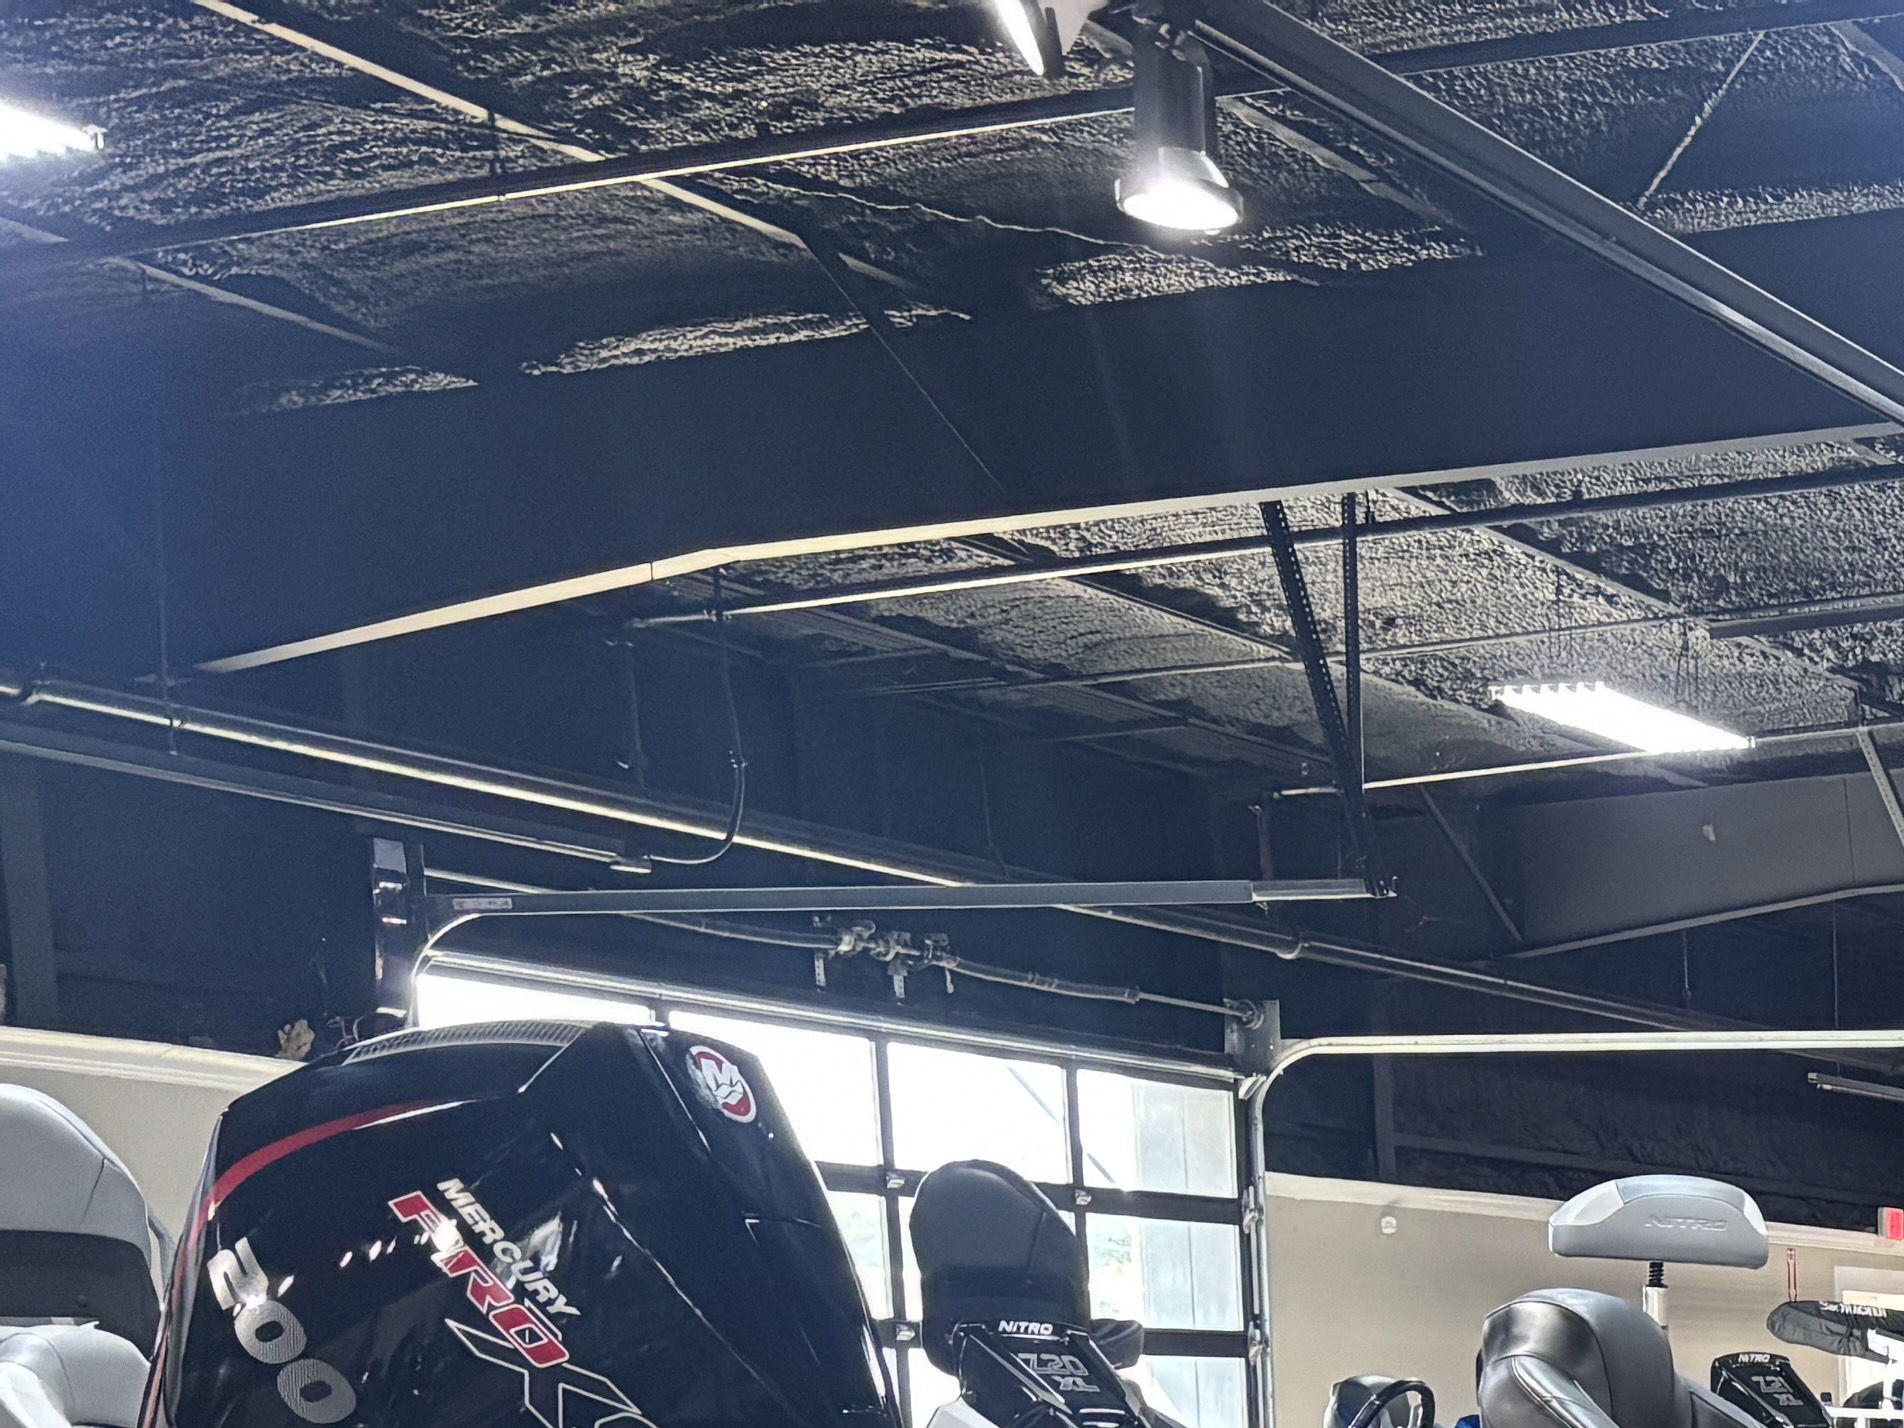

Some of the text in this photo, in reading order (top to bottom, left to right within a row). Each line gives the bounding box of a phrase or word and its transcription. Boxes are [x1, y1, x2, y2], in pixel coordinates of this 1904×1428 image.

[388, 1190, 570, 1368] PRO
[437, 1178, 581, 1316] MERCURY
[206, 1237, 357, 1425] 200
[998, 1319, 1054, 1336] NITRO
[1017, 1352, 1090, 1377] Z20
[1738, 1353, 1770, 1364] NITRO
